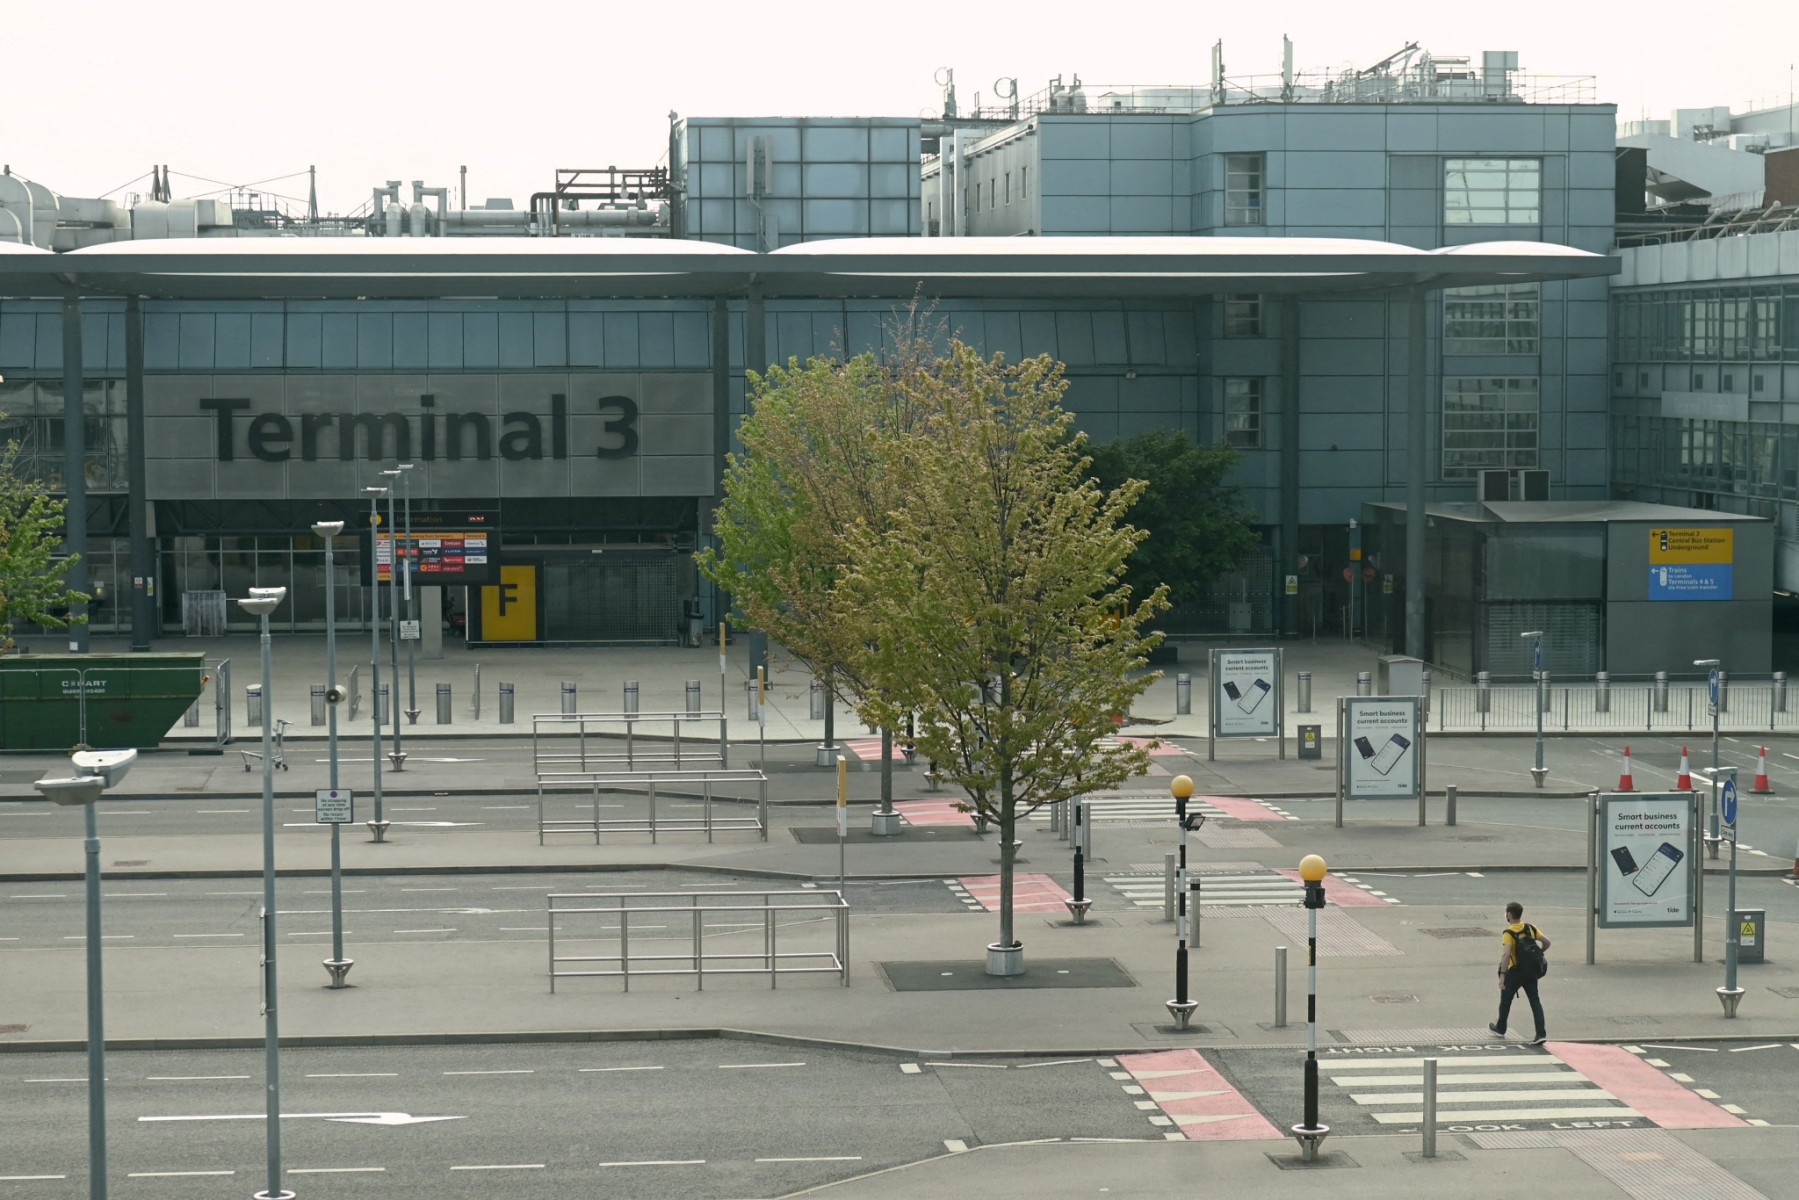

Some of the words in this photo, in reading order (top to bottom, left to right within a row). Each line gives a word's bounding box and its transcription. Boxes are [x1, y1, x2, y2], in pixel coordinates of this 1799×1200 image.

[200, 394, 567, 462] Terminal
[597, 396, 639, 461] 3
[499, 584, 518, 616] F
[1618, 812, 1642, 820] Smart
[1644, 812, 1678, 820] business
[1644, 822, 1680, 830] accounts
[1438, 1044, 1526, 1052] LOOK
[1550, 1120, 1634, 1130] LEFT
